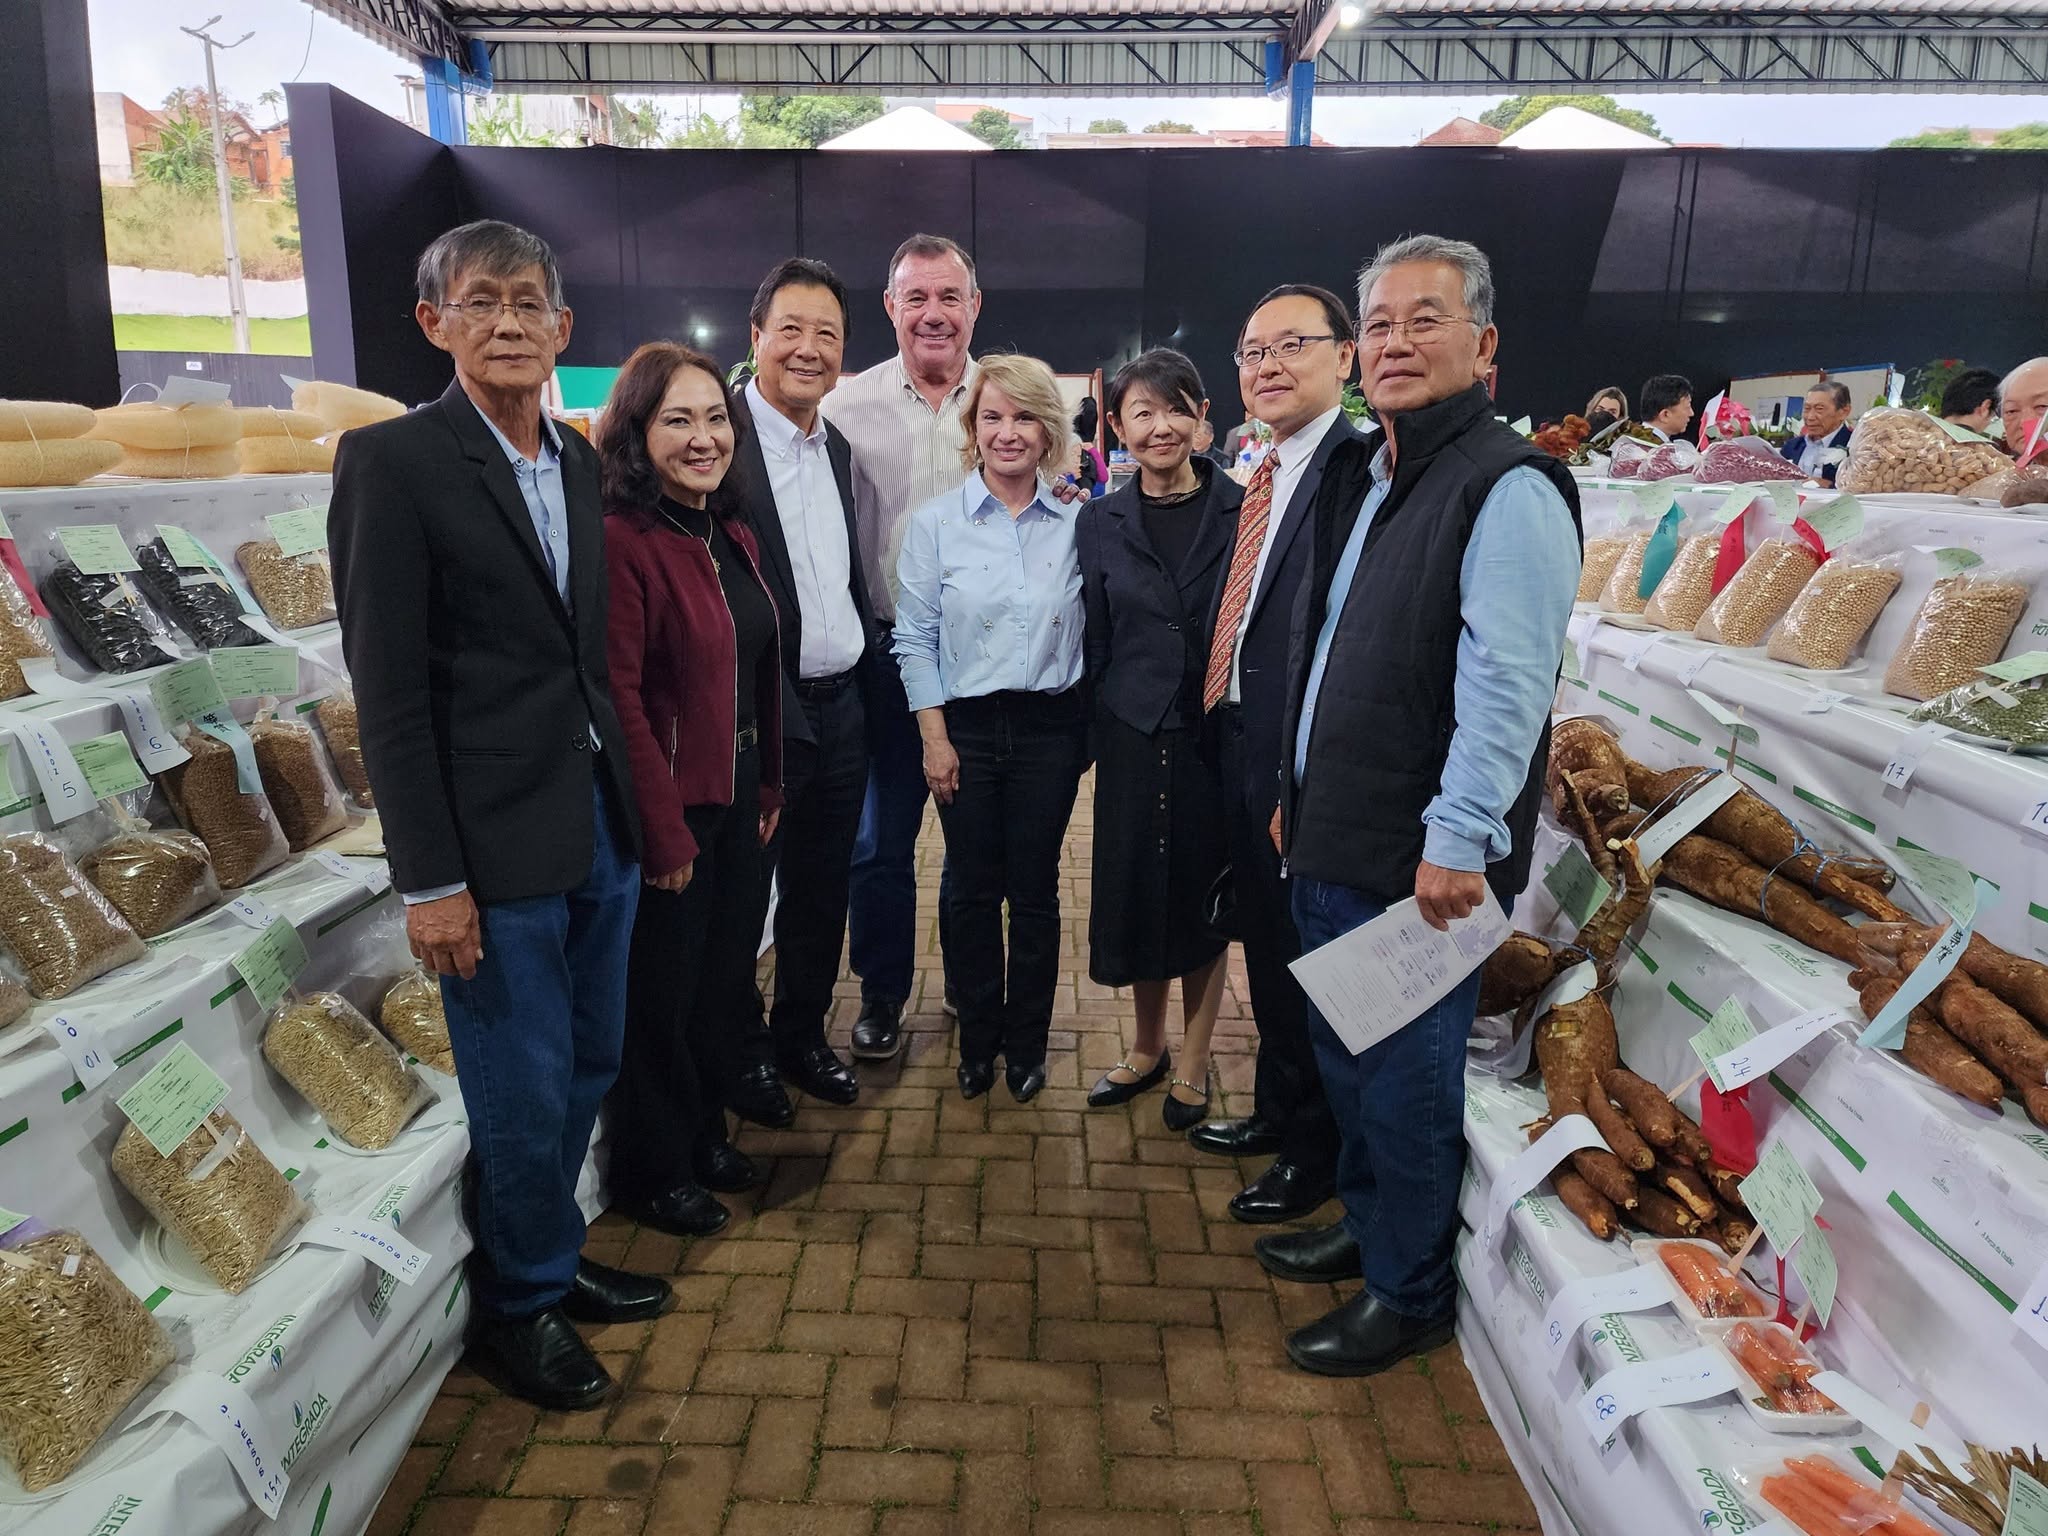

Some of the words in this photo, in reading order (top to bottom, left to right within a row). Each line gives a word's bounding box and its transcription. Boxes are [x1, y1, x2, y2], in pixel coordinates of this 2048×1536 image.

[36, 732, 59, 776] ARROZ
[149, 736, 162, 749] 6
[1887, 762, 1905, 779] 17
[62, 781, 77, 798] 5
[1731, 1057, 1750, 1077] 24
[401, 1254, 420, 1275] 150
[1550, 1320, 1563, 1346] 67
[1600, 1313, 1641, 1363] NTEGRA
[229, 1314, 297, 1384] INTEGRADA
[1596, 1394, 1616, 1420] 68
[264, 1474, 282, 1504] 151
[1696, 1467, 1746, 1535] EGRADA
